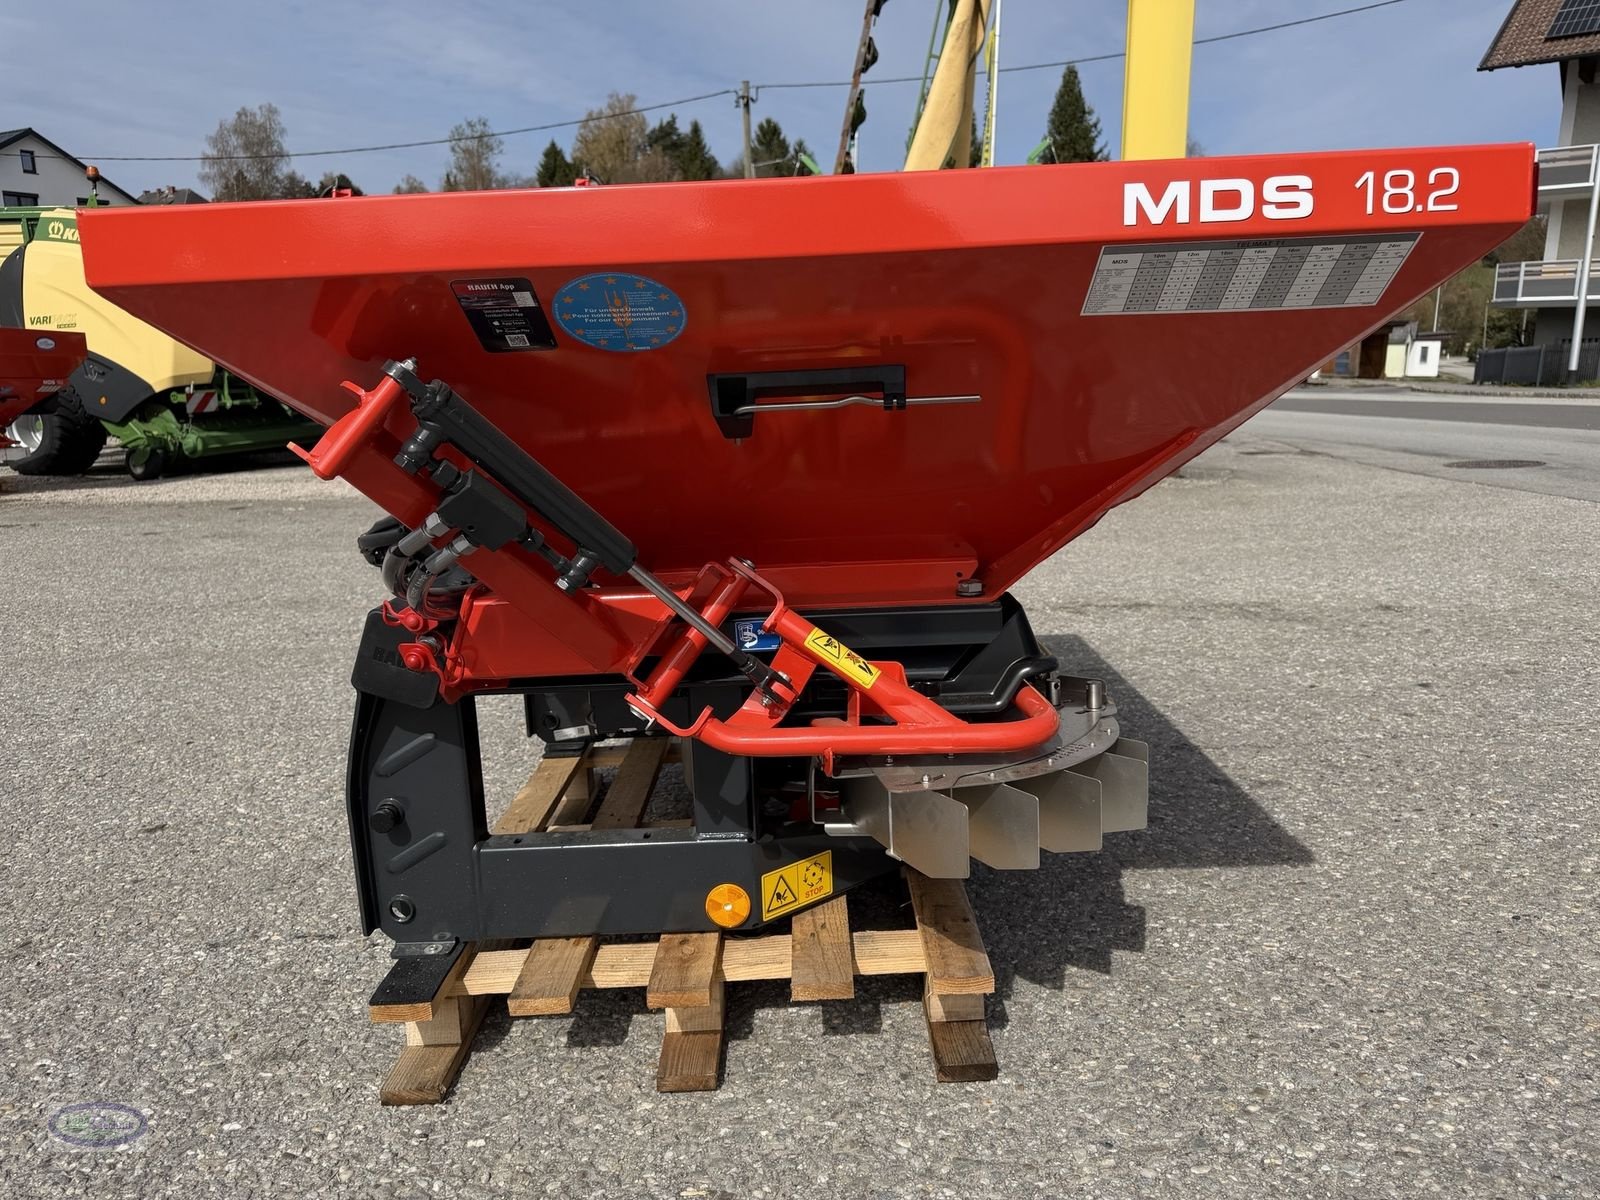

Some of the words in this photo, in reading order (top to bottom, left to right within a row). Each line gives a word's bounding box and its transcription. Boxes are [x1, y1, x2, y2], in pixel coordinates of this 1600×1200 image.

[1123, 175, 1314, 226] MDS
[1354, 167, 1460, 215] 18.2
[804, 885, 824, 899] STOP
